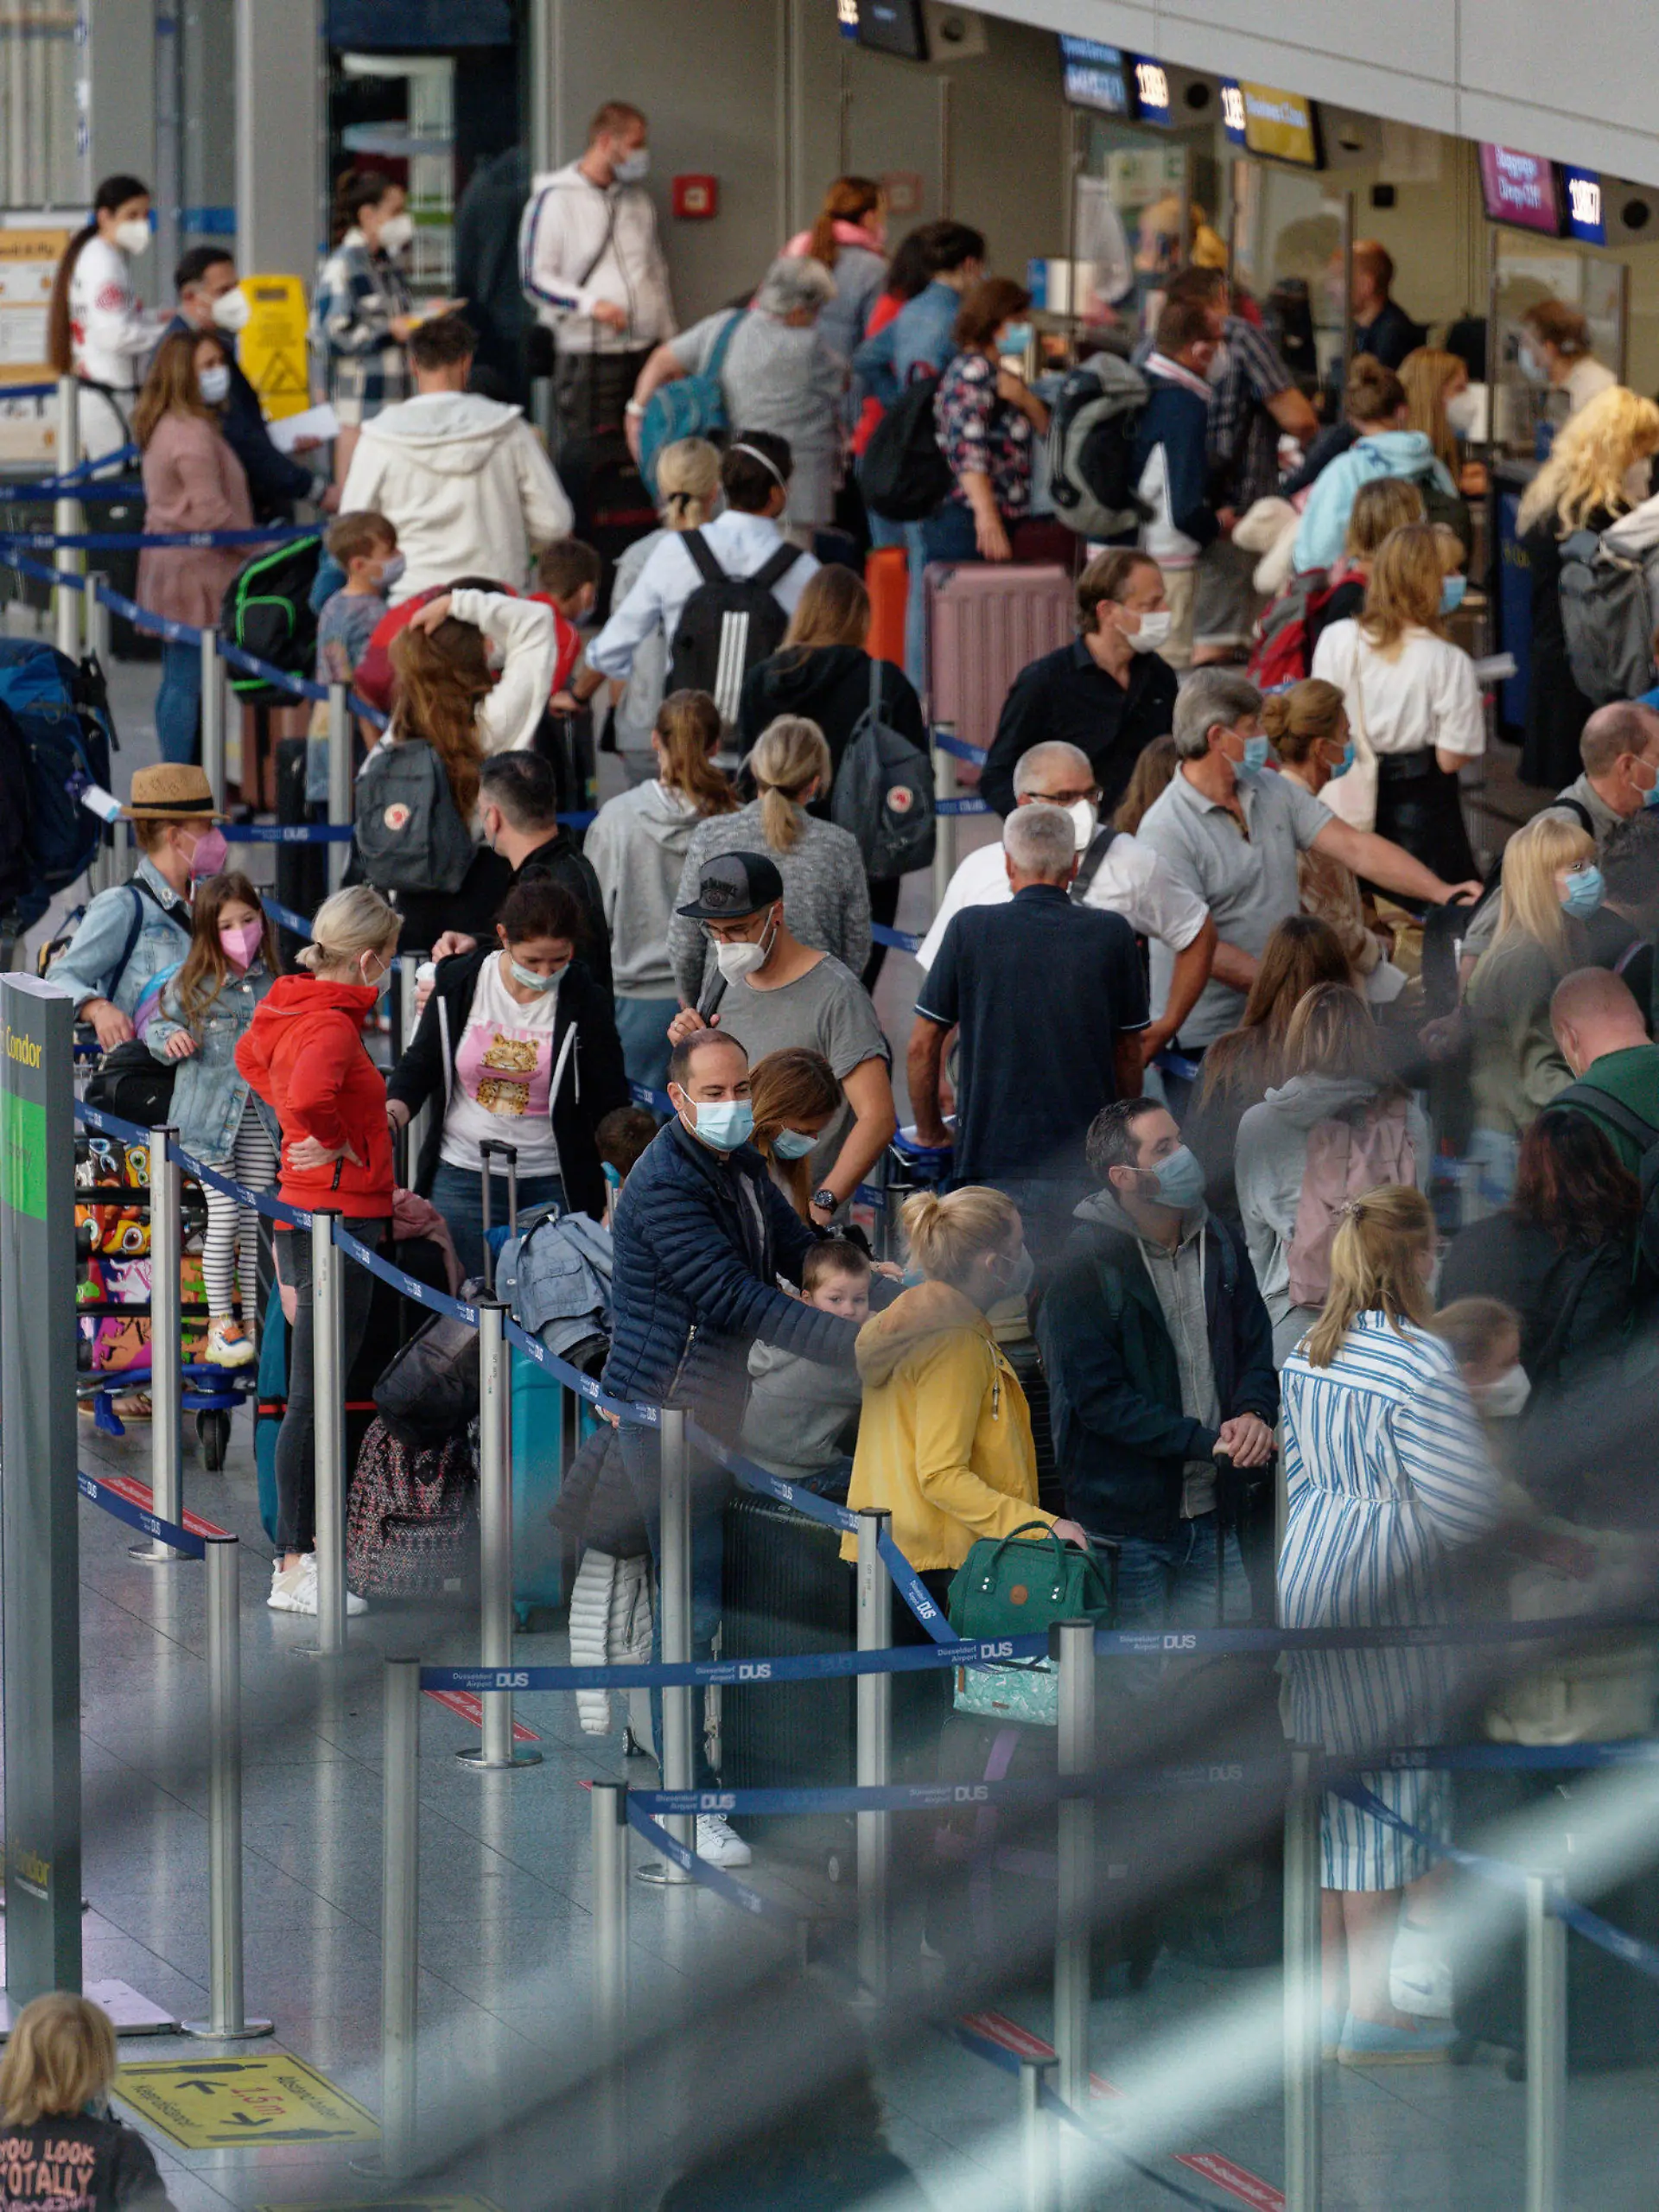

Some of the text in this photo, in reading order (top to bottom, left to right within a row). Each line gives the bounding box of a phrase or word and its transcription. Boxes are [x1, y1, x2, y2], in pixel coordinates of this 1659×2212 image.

[7, 1025, 41, 1069] Condor
[535, 1344, 544, 1362] DUS
[590, 1381, 600, 1398] DUS
[647, 1402, 658, 1422] DUS
[87, 1481, 98, 1499] DUS
[782, 1483, 793, 1501] DUS
[916, 1600, 937, 1620] DUS
[980, 1641, 1014, 1660] DUS
[1163, 1634, 1197, 1649] DUS
[950, 1654, 977, 1662] Airport
[495, 1672, 530, 1688] DUS
[738, 1663, 772, 1680] DUS
[700, 1793, 736, 1810] DUS
[954, 1785, 989, 1802] DUS
[43, 2139, 96, 2165] LOOK
